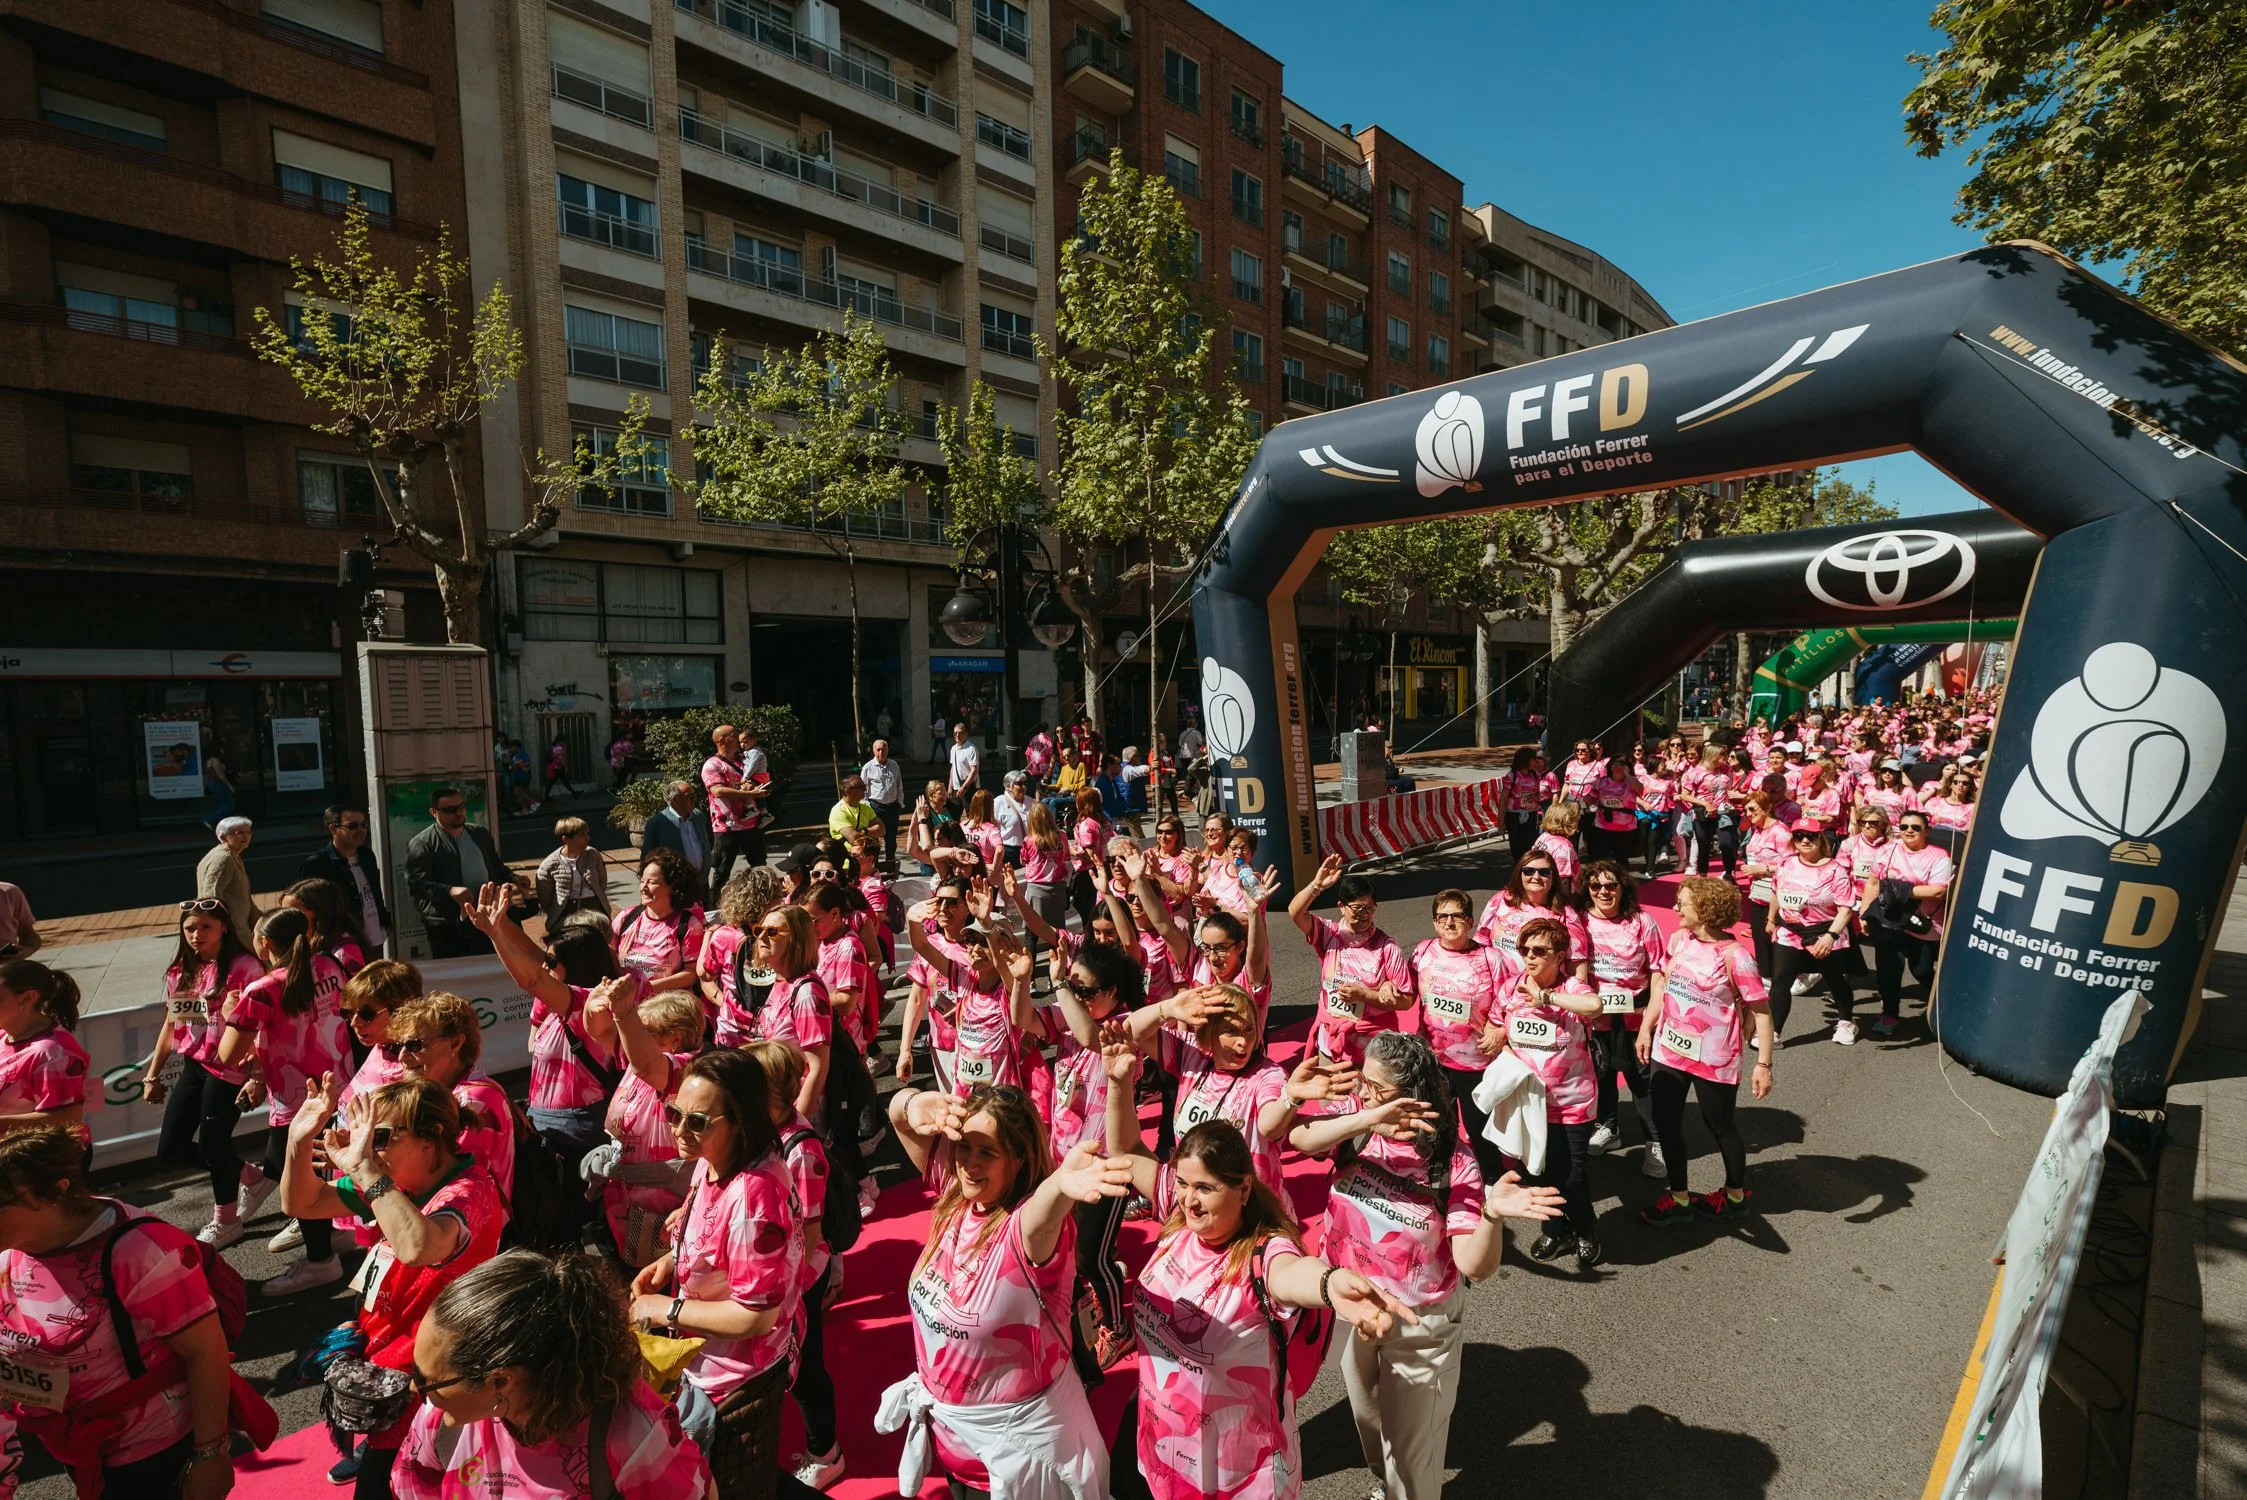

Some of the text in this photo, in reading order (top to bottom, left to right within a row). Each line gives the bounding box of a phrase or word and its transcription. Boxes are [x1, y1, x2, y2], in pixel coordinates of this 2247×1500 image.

[1507, 363, 1649, 449] FFD
[1509, 433, 1649, 470] Fundación Ferrer
[1514, 450, 1653, 486] para el Deporte
[1283, 643, 1312, 856] www.fundacionferrer.org
[1211, 776, 1265, 814] FD
[1238, 817, 1267, 826] Ferrer
[1783, 895, 1803, 905] 4197
[1977, 849, 2180, 949] FFD
[1972, 914, 2160, 974] Fundación Ferrer
[1968, 933, 2155, 992] para el Deporte
[1670, 971, 1694, 984] Carrera
[173, 1000, 207, 1014] 3905
[502, 992, 533, 1004] asocia
[1433, 996, 1464, 1015] 9258
[1600, 994, 1626, 1006] 5732
[1517, 1020, 1547, 1036] 9259
[1668, 1030, 1692, 1050] 5729
[1352, 1175, 1386, 1200] por la
[1348, 1186, 1429, 1232] Investigación
[913, 1281, 942, 1310] por la
[1134, 1286, 1168, 1324] Carrera
[1146, 1315, 1155, 1332] la
[0, 1361, 53, 1392] 5156
